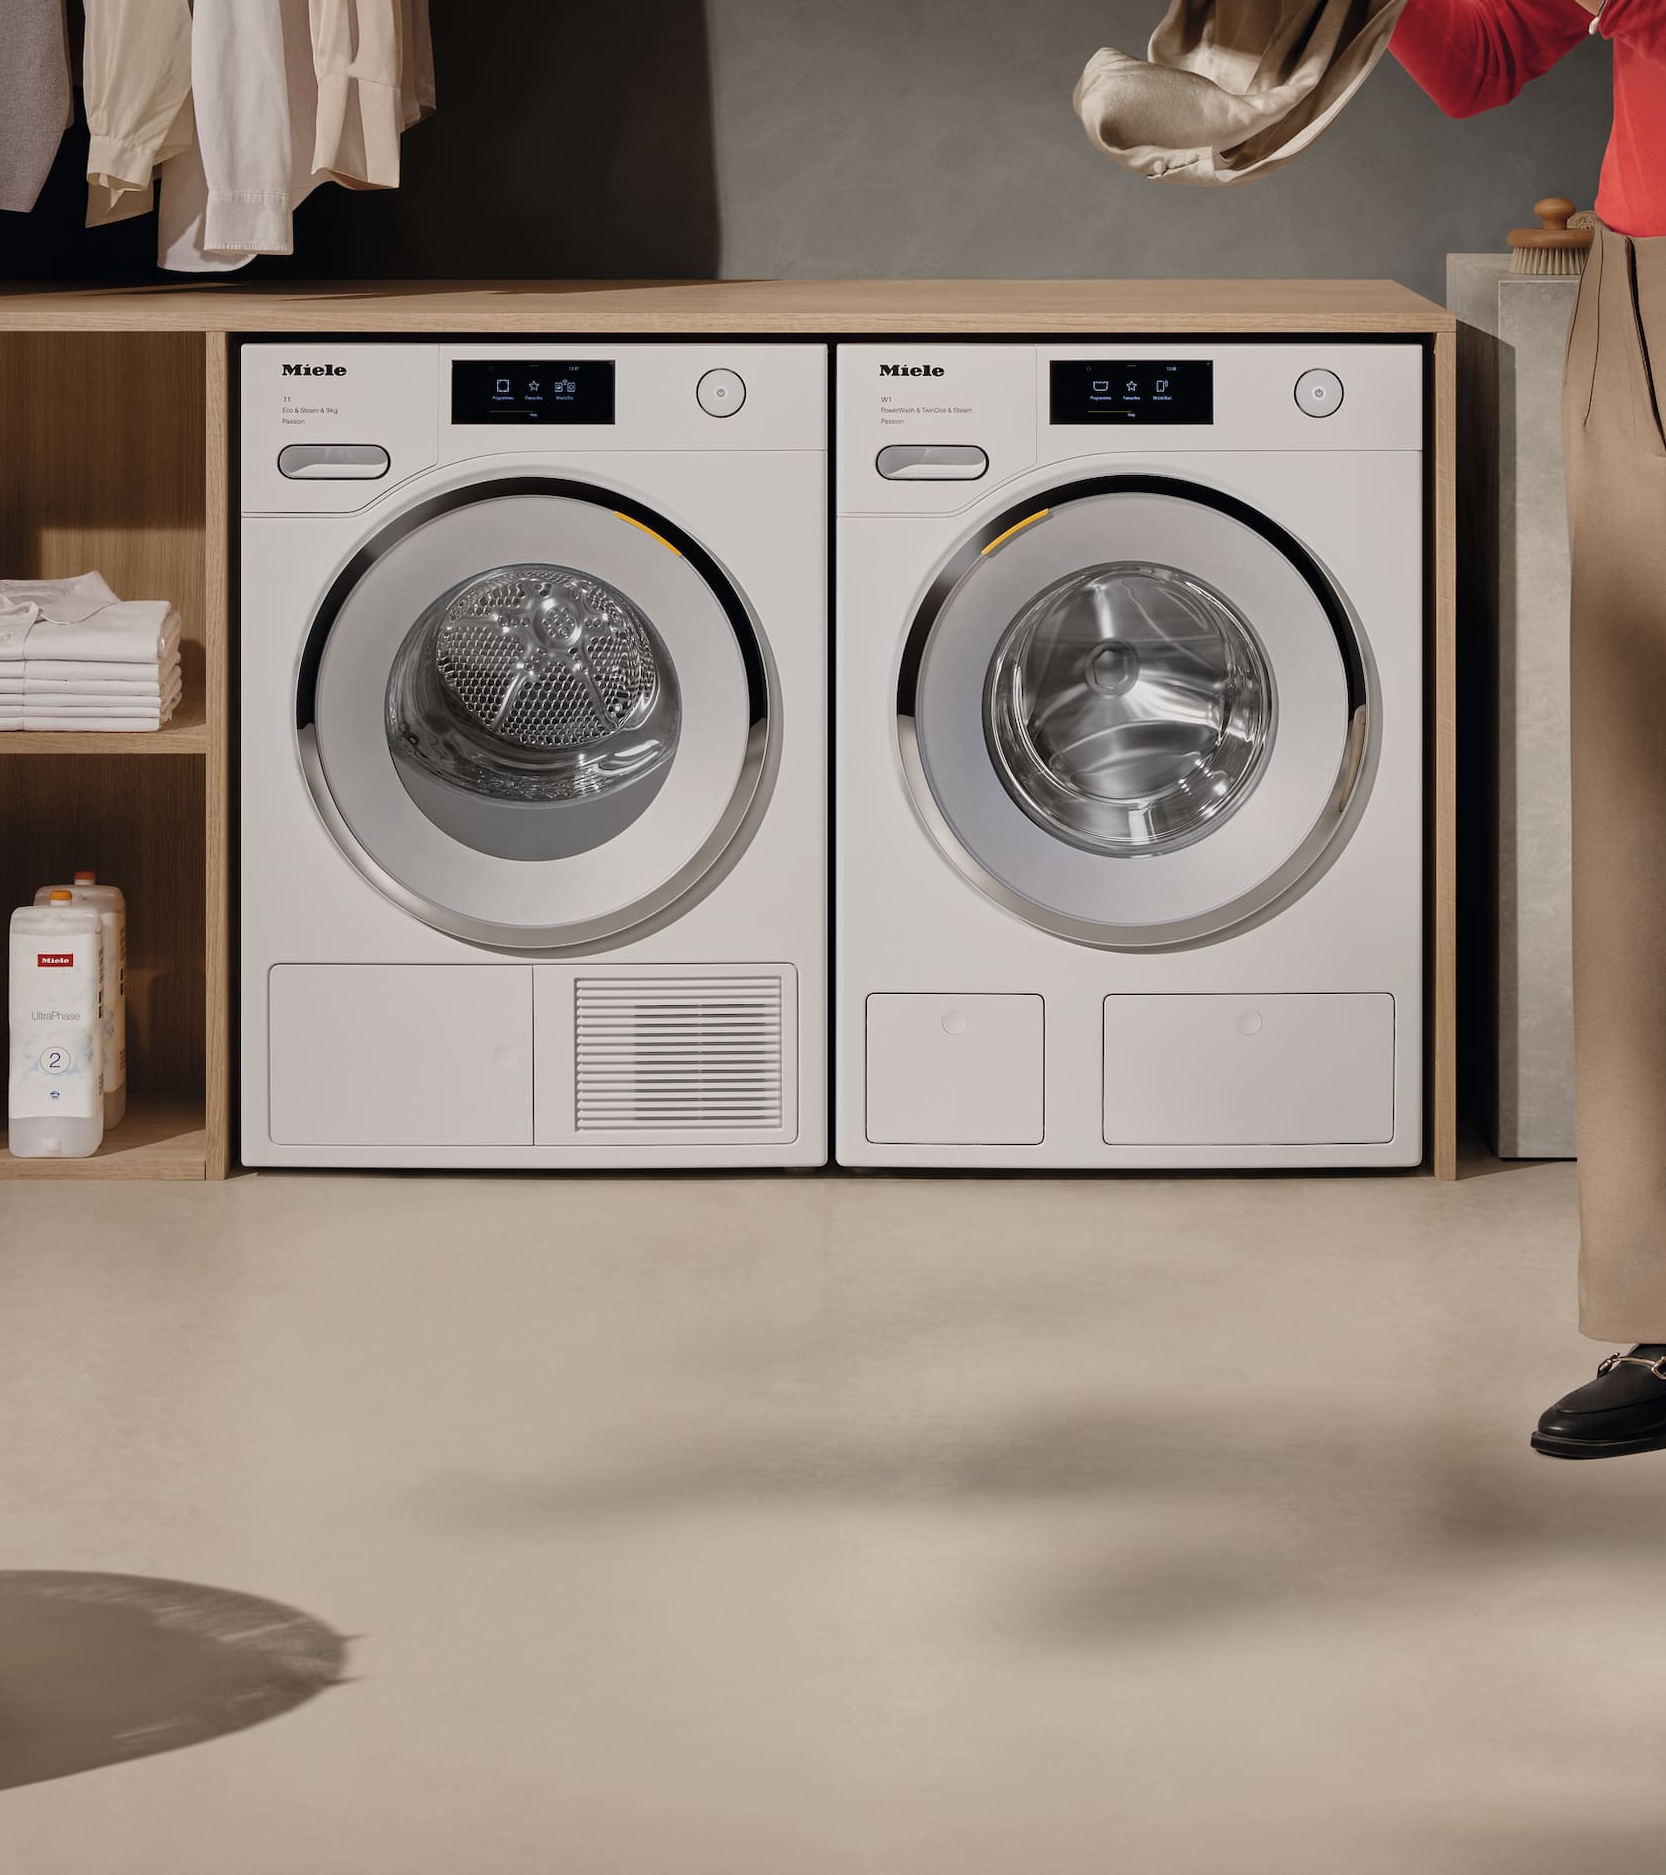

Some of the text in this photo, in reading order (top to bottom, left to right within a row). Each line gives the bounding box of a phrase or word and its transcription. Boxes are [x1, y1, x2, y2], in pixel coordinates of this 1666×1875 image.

[282, 364, 347, 377] Miele
[879, 364, 945, 377] Miele
[31, 1011, 81, 1021] UltraPhase
[49, 1052, 62, 1068] 2
